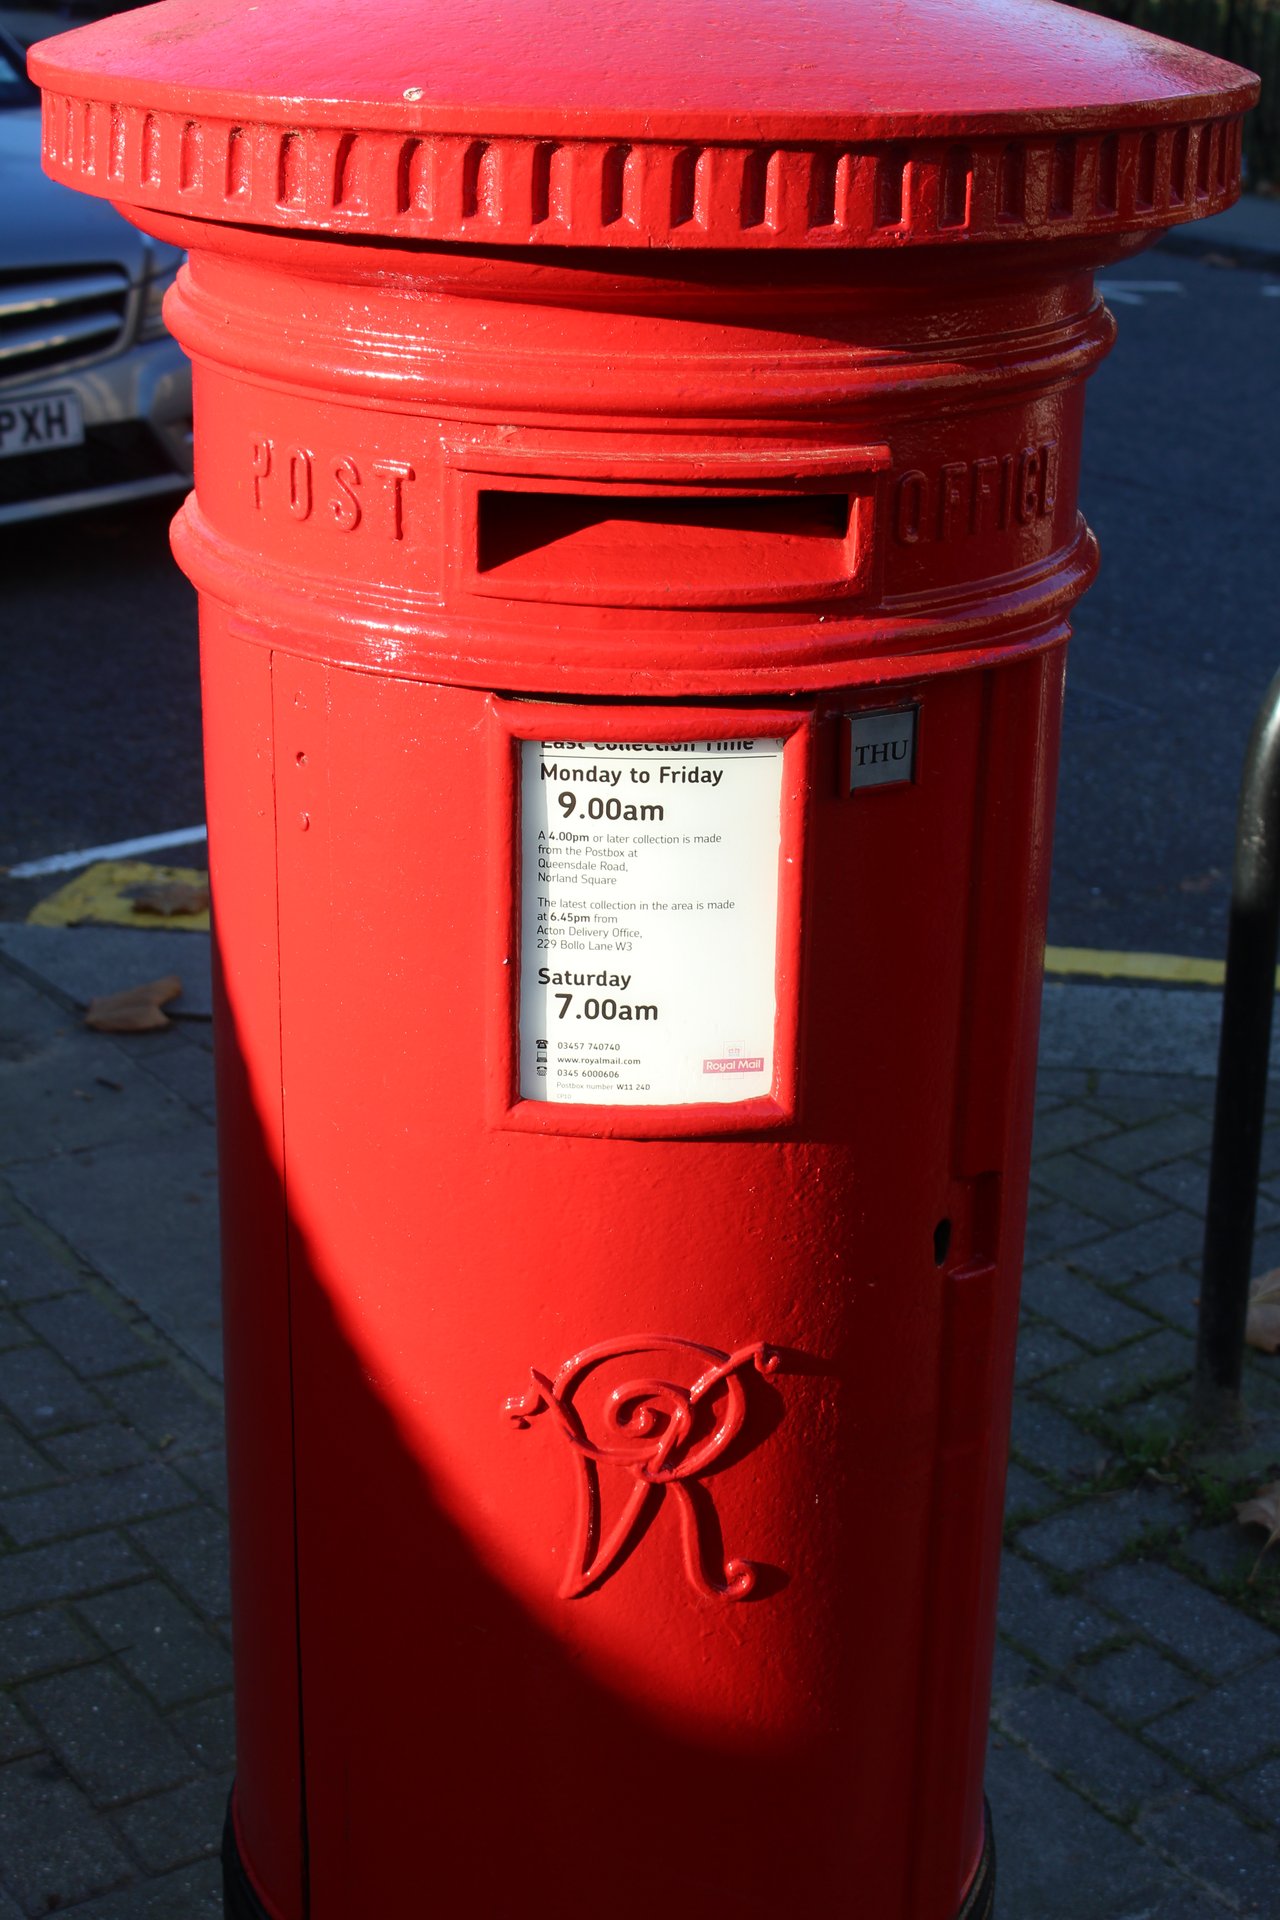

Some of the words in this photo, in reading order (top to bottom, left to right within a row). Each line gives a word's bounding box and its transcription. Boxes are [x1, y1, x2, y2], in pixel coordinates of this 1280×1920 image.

[252, 434, 416, 541] POST
[855, 740, 909, 766] THU
[541, 762, 622, 787] Monday
[630, 767, 650, 783] to
[660, 766, 723, 787] Friday
[557, 791, 664, 821] 9.00am
[538, 830, 546, 840] A
[549, 831, 589, 843] 4.00pm
[593, 835, 603, 843] or
[607, 834, 629, 843] later
[633, 834, 680, 844] collection
[683, 834, 690, 844] is
[694, 833, 722, 843] made
[538, 844, 562, 855] from
[565, 846, 582, 856] the
[585, 846, 625, 857] Postbox
[628, 849, 638, 857] at
[538, 858, 597, 870] Queensdale
[600, 861, 628, 872] Road,
[538, 872, 577, 883] Norland
[581, 874, 617, 886] Square
[537, 897, 556, 908] The
[560, 898, 587, 909] latest
[590, 900, 636, 910] collection
[640, 901, 648, 910] in
[652, 901, 668, 910] the
[671, 902, 693, 910] area
[696, 900, 704, 910] is
[707, 899, 735, 910] made
[537, 912, 547, 921] at
[550, 912, 590, 924] 6.45pm
[594, 914, 618, 923] from
[537, 925, 565, 935] Acton
[569, 926, 609, 939] Delivery
[612, 927, 643, 938] Office,
[537, 938, 557, 949] 229
[560, 939, 585, 950] Bollo
[589, 941, 613, 950] Lane
[615, 941, 632, 951] W3
[538, 967, 632, 990] Saturday
[555, 993, 658, 1021] 7.00am
[557, 1042, 584, 1050] 03457
[588, 1043, 621, 1051] 740740
[557, 1057, 641, 1065] www.royalmail.com
[706, 1061, 736, 1071] Royal
[738, 1060, 761, 1069] Mail
[557, 1069, 579, 1077] 0345
[582, 1070, 620, 1078] 6000606
[556, 1081, 583, 1089] Postbox
